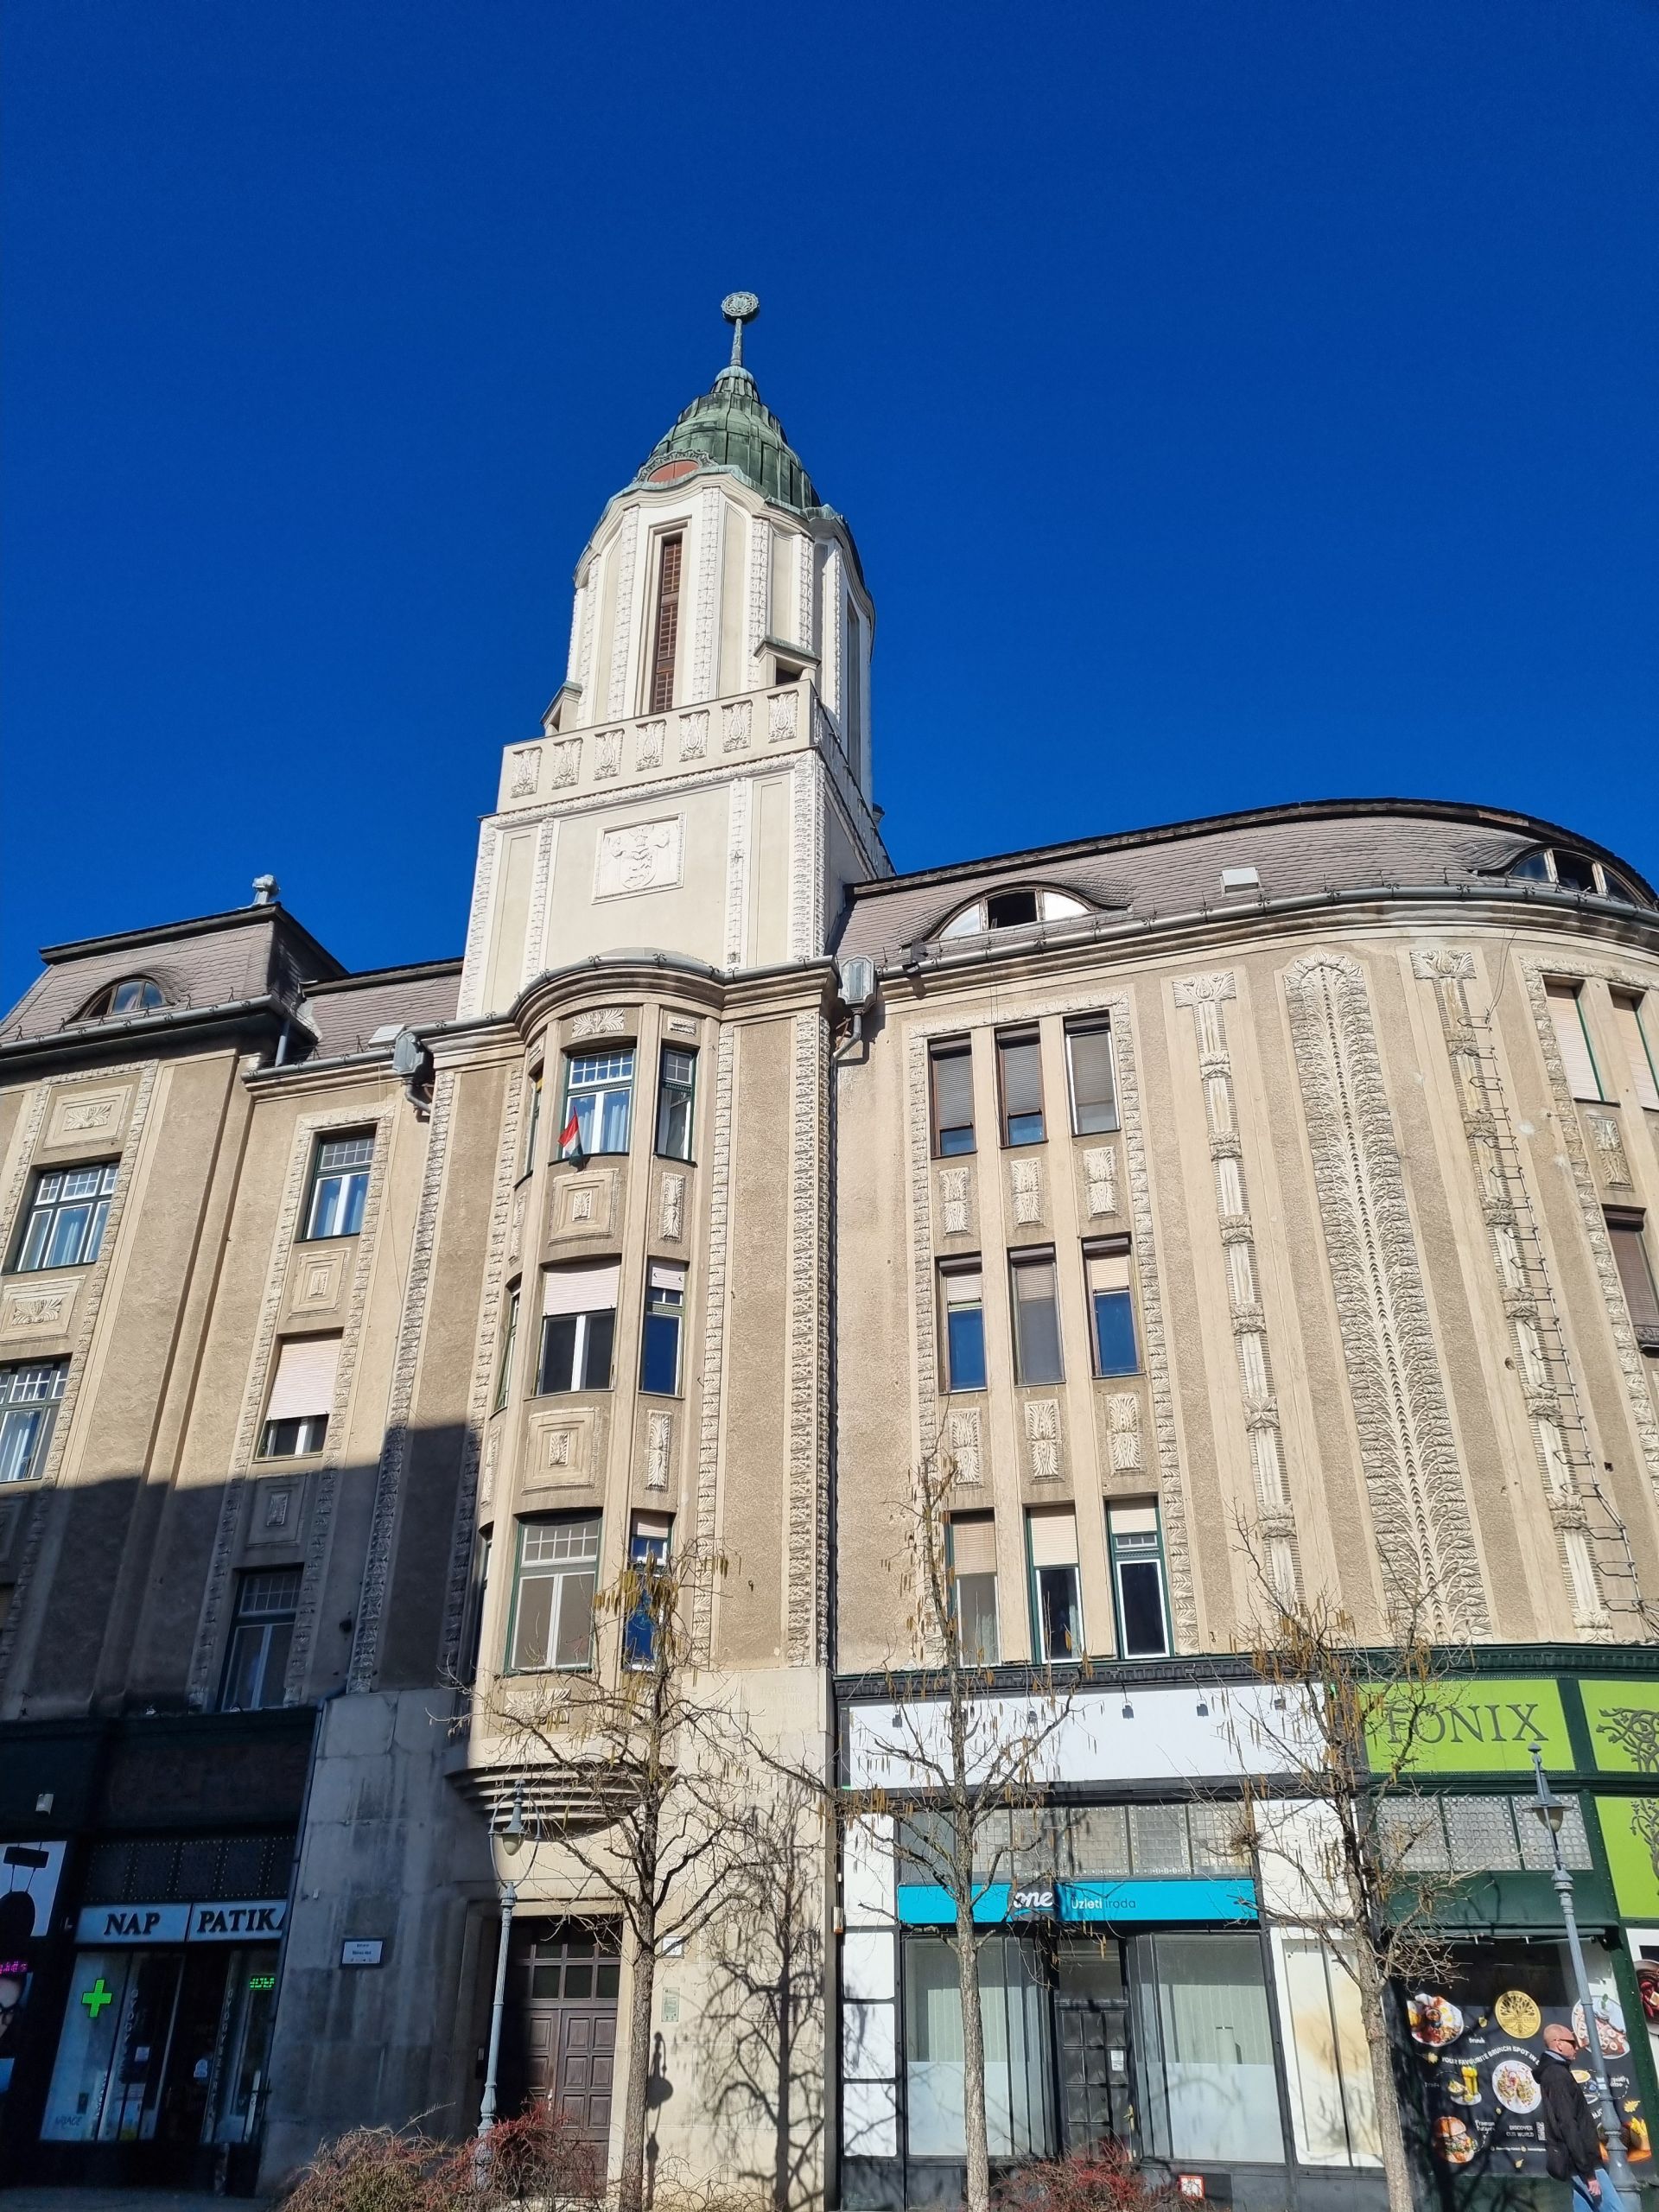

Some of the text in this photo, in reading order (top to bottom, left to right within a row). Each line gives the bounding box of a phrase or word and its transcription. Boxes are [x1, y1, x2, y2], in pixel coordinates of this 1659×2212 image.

[1013, 1891, 1053, 1909] one
[1105, 1897, 1136, 1909] iroda
[104, 1911, 160, 1936] NAP
[1488, 2045, 1512, 2057] BRUNCH
[1512, 2045, 1530, 2056] SPOT
